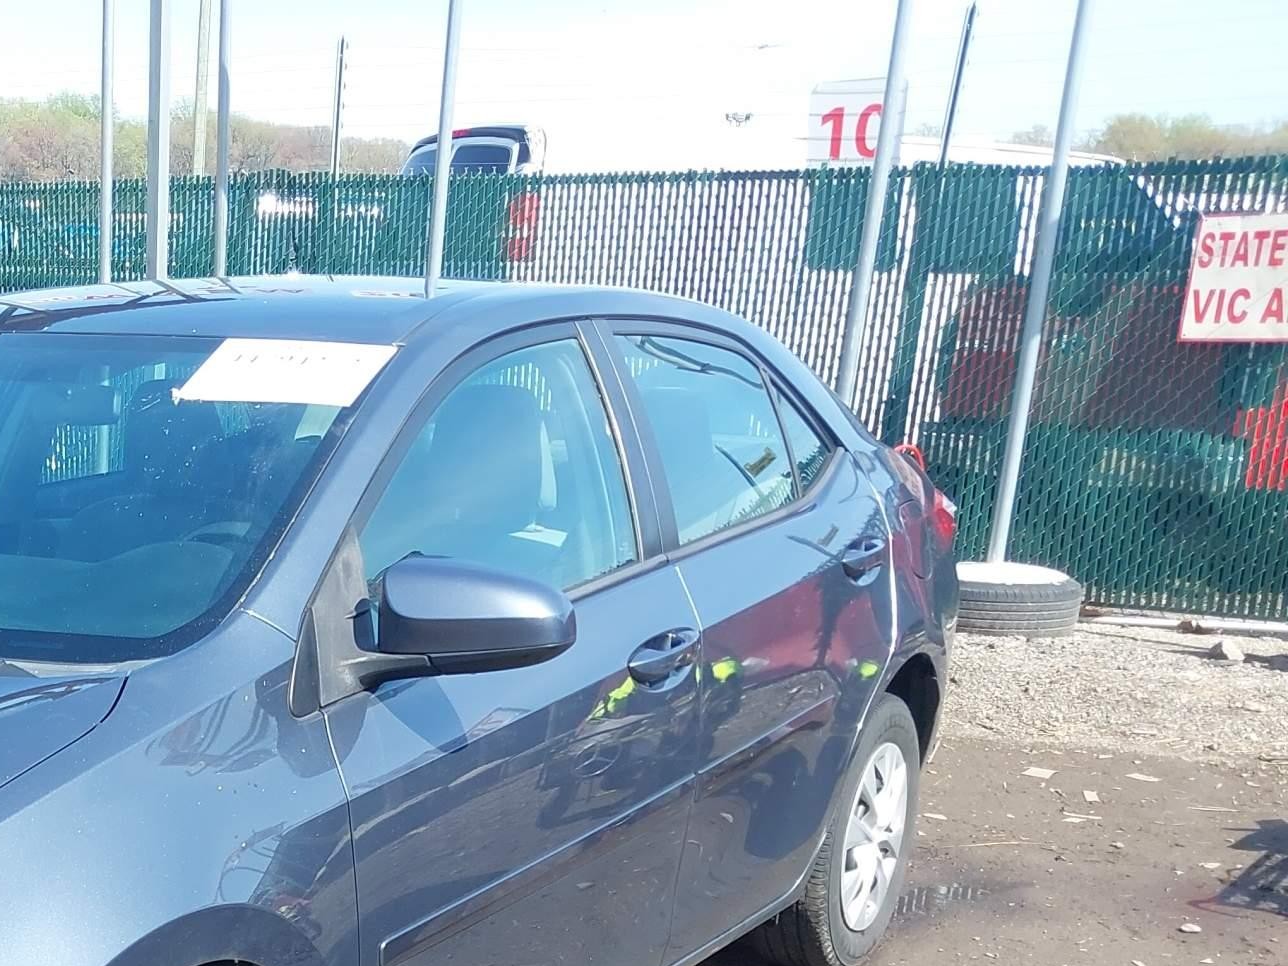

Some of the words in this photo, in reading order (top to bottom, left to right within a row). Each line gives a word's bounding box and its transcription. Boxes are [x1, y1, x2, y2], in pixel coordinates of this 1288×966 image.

[1198, 230, 1288, 268] STATE
[1193, 288, 1251, 324] VIC
[1260, 288, 1288, 323] A
